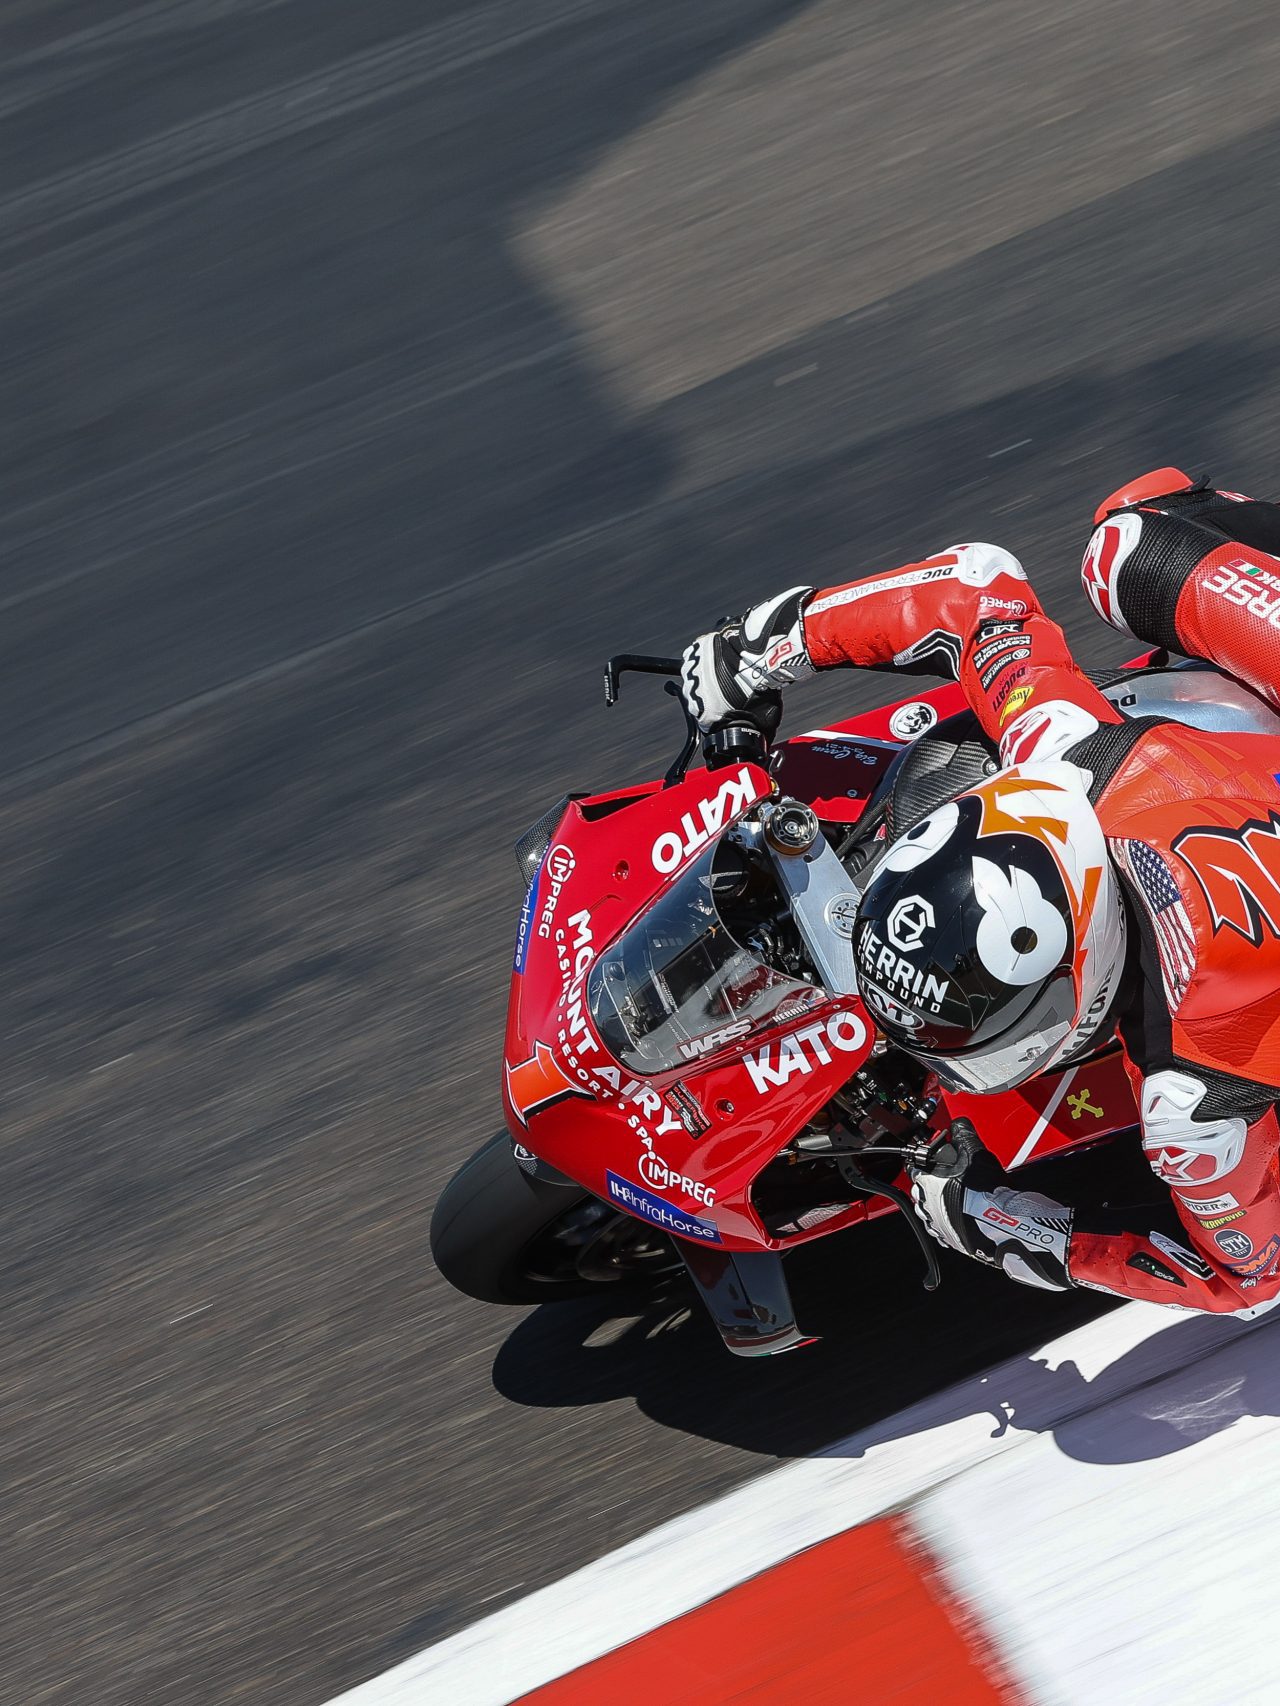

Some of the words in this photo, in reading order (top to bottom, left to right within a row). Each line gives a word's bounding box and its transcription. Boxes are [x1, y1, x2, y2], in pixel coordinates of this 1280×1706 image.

[769, 641, 793, 667] GP
[976, 639, 1030, 669] Keystone
[992, 666, 1026, 712] DUCATI
[651, 766, 757, 874] KATO
[538, 850, 575, 939] IMPREG
[555, 928, 572, 1008] CASINO
[858, 945, 941, 1014] COMPOUND
[860, 921, 950, 1003] HERRIN
[567, 909, 600, 1056] MOUNT
[591, 1065, 683, 1136] AIRY
[772, 1003, 810, 1023] HERRIN
[557, 1028, 614, 1099] RESORT
[679, 1018, 752, 1060] WRS
[742, 1011, 867, 1095] KATO
[627, 1115, 653, 1151] SPA
[640, 1154, 717, 1208] IMPREG
[630, 1191, 715, 1239] InfraHorse
[982, 1207, 1020, 1227] GP
[1015, 1222, 1055, 1245] PRO
[1220, 1235, 1249, 1253] STM
